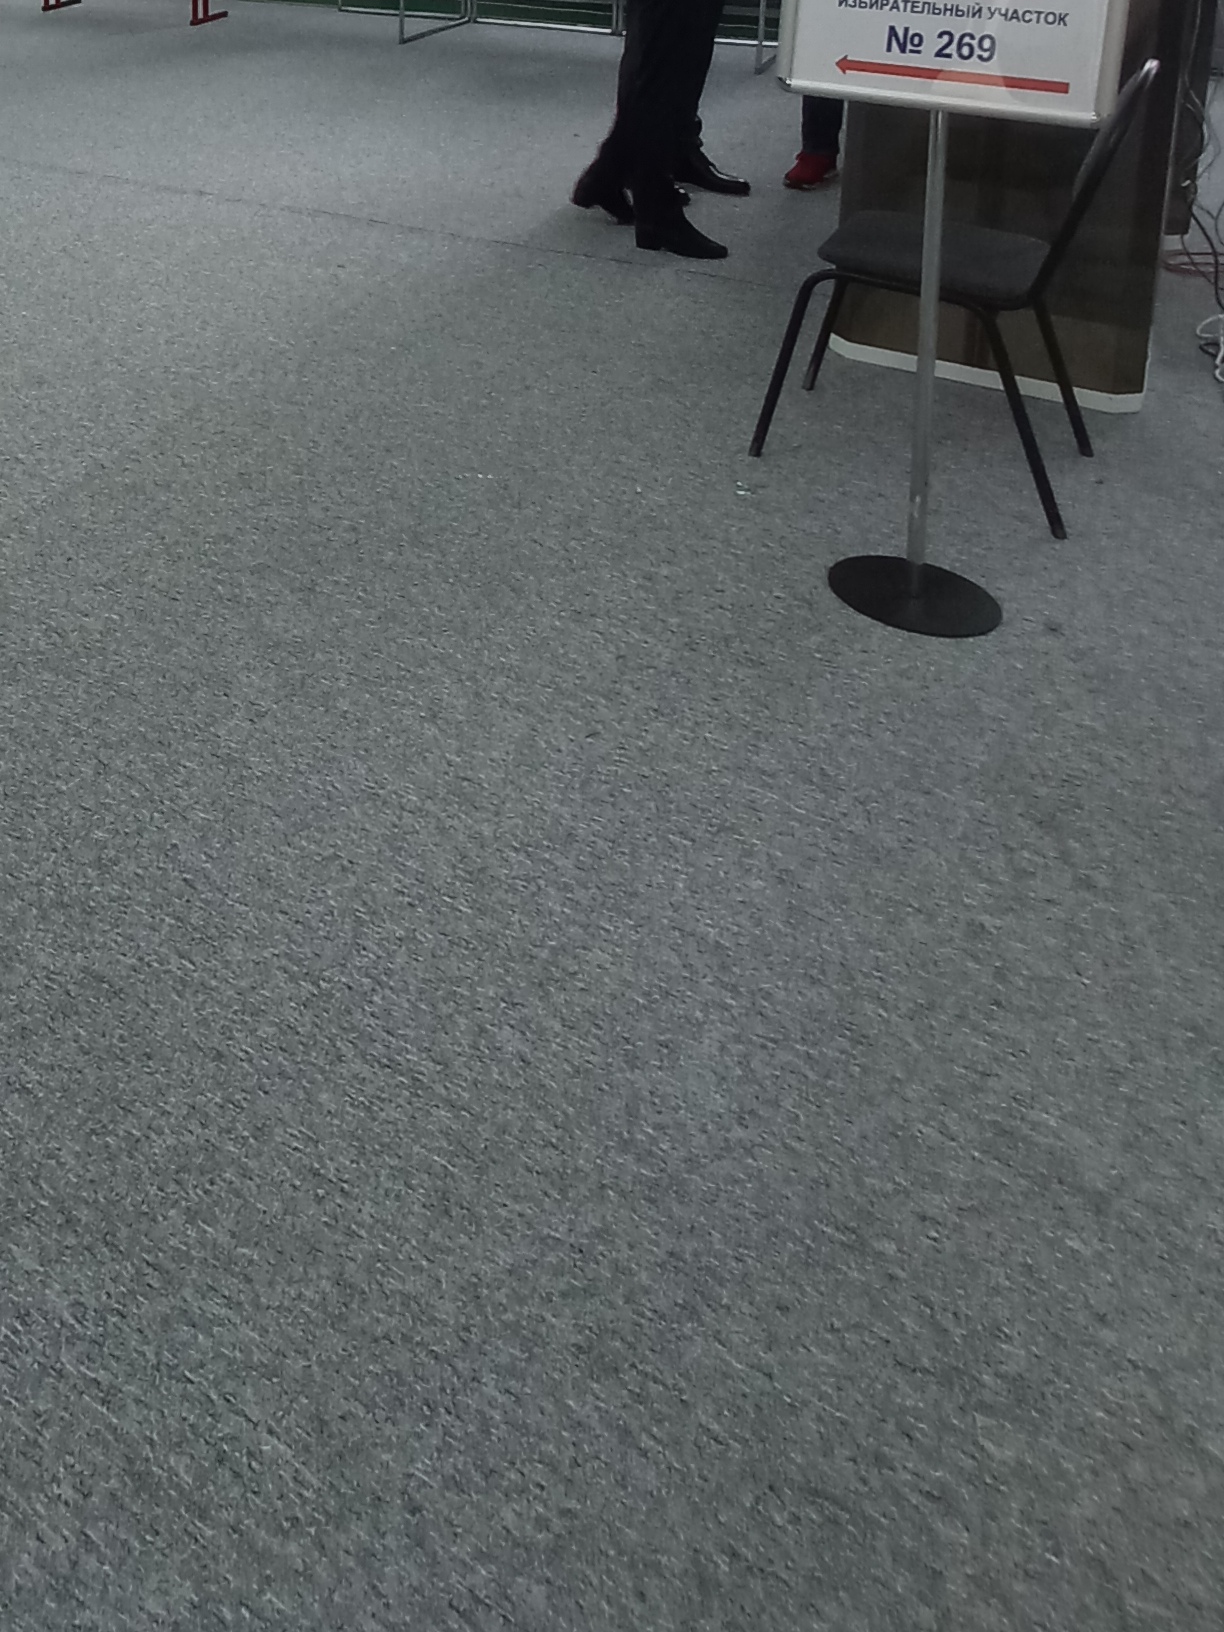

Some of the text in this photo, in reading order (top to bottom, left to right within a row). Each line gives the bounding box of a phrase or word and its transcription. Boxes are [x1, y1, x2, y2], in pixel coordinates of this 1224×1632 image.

[987, 6, 1070, 27] УЧАСТОК
[885, 24, 997, 63] № 269
